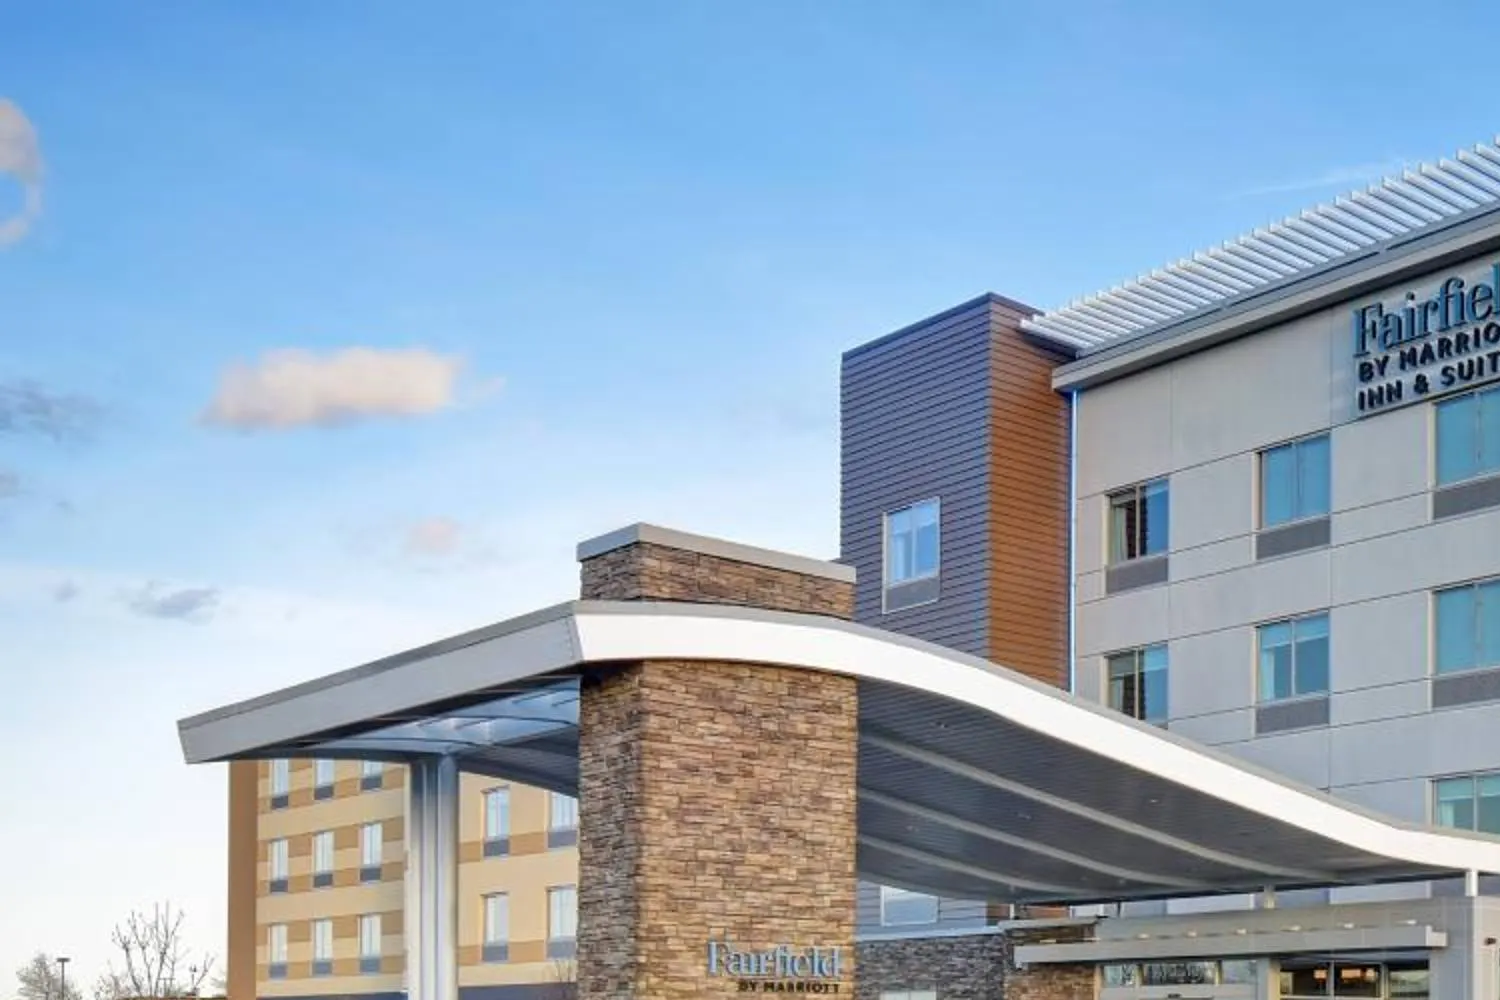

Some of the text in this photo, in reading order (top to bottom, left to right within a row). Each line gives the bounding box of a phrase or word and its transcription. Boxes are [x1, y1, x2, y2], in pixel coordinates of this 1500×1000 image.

[1358, 355, 1390, 383] BY
[1358, 380, 1403, 411] INN
[1413, 373, 1430, 395] &
[707, 941, 842, 979] Fairfield
[737, 980, 841, 993] BY MARRIOTT
